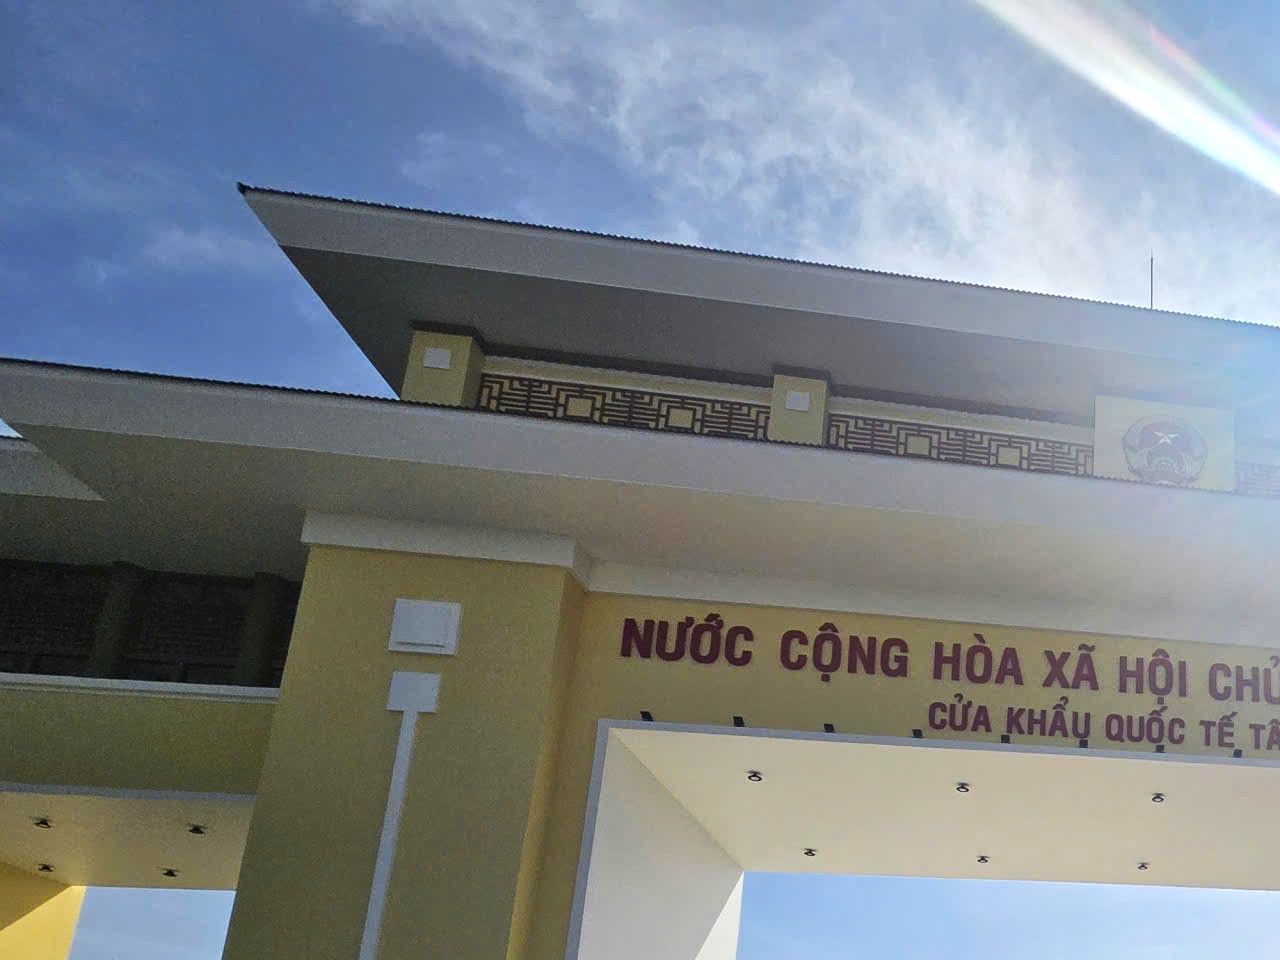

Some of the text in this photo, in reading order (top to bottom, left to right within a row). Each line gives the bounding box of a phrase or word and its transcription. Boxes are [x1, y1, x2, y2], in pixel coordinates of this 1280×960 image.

[620, 613, 754, 667] NƯỚC
[780, 622, 909, 682] CỘNG
[933, 632, 1024, 686] HÒA
[1043, 644, 1099, 691] XÃ
[1118, 648, 1187, 704] HỘI
[928, 693, 992, 733] CỬA
[1005, 697, 1091, 739] KHẨU
[1105, 706, 1185, 746] QUỐC
[1200, 711, 1238, 749] TẾ
